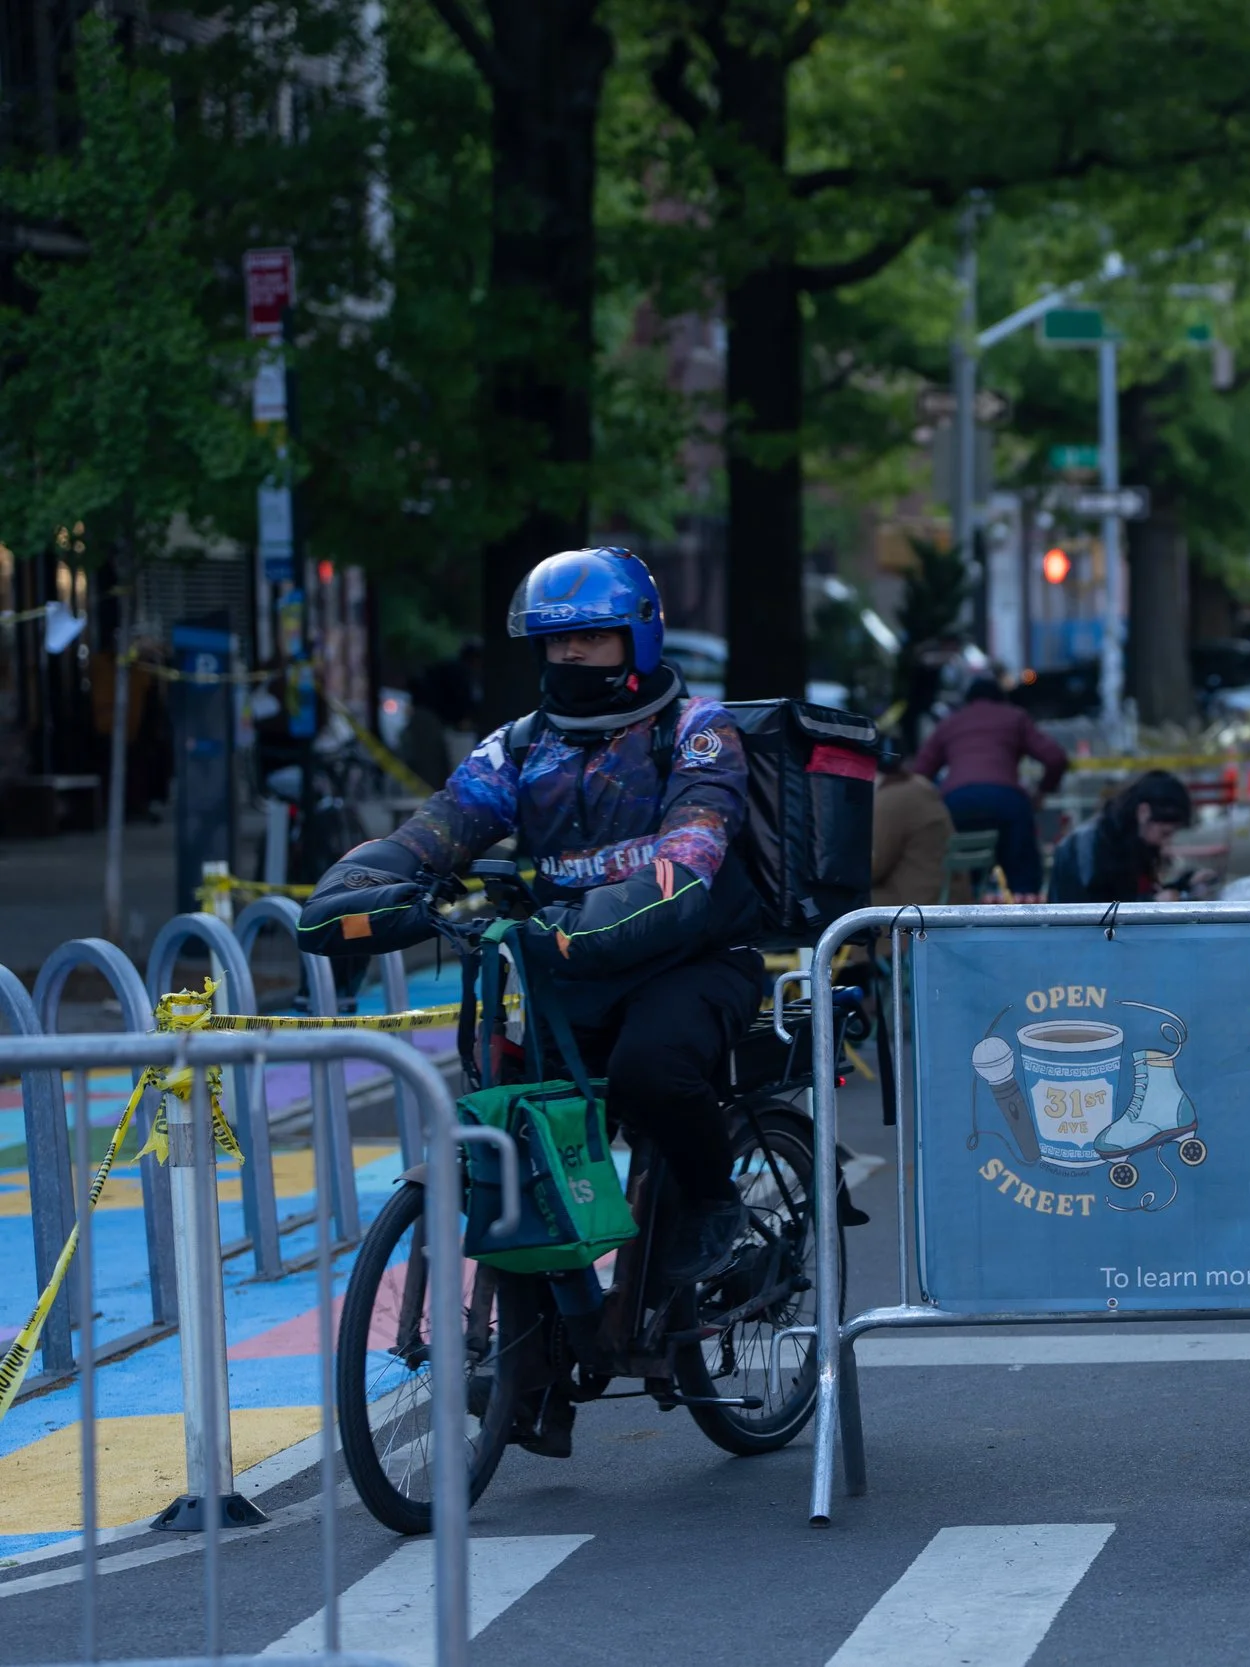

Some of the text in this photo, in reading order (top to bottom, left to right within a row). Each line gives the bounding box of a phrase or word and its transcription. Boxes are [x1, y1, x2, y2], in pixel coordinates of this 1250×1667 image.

[1026, 986, 1106, 1013] OPEN
[1058, 1121, 1088, 1133] AVE
[979, 1158, 1095, 1216] STREET
[1100, 1267, 1129, 1288] To
[1137, 1266, 1197, 1288] learn
